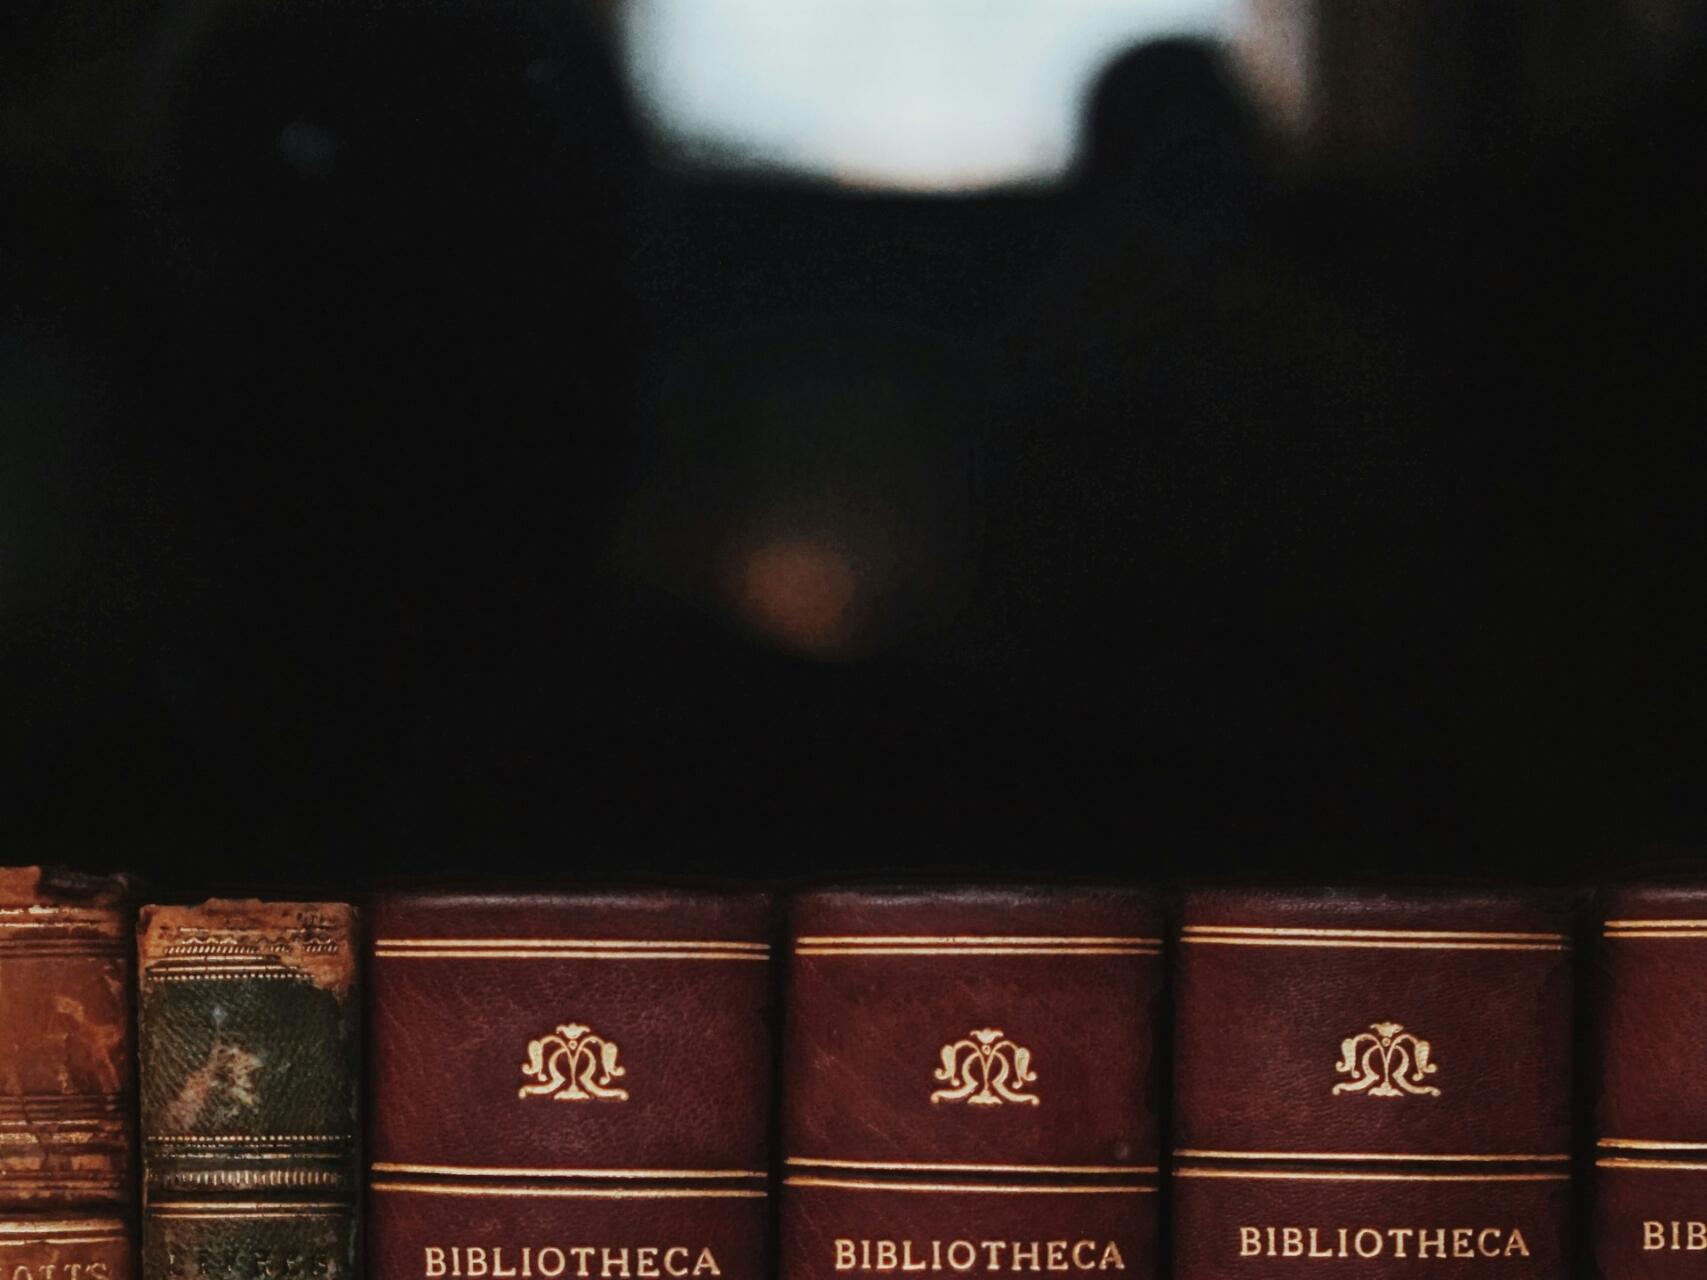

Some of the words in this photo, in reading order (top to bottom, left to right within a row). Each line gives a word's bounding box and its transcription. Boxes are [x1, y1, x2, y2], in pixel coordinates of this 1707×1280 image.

[1239, 1226, 1530, 1259] BIBLIOTHECA
[1642, 1220, 1707, 1251] BIB
[424, 1246, 721, 1279] BIBLIOTHECA
[834, 1238, 1126, 1273] BIBLIOTHECA
